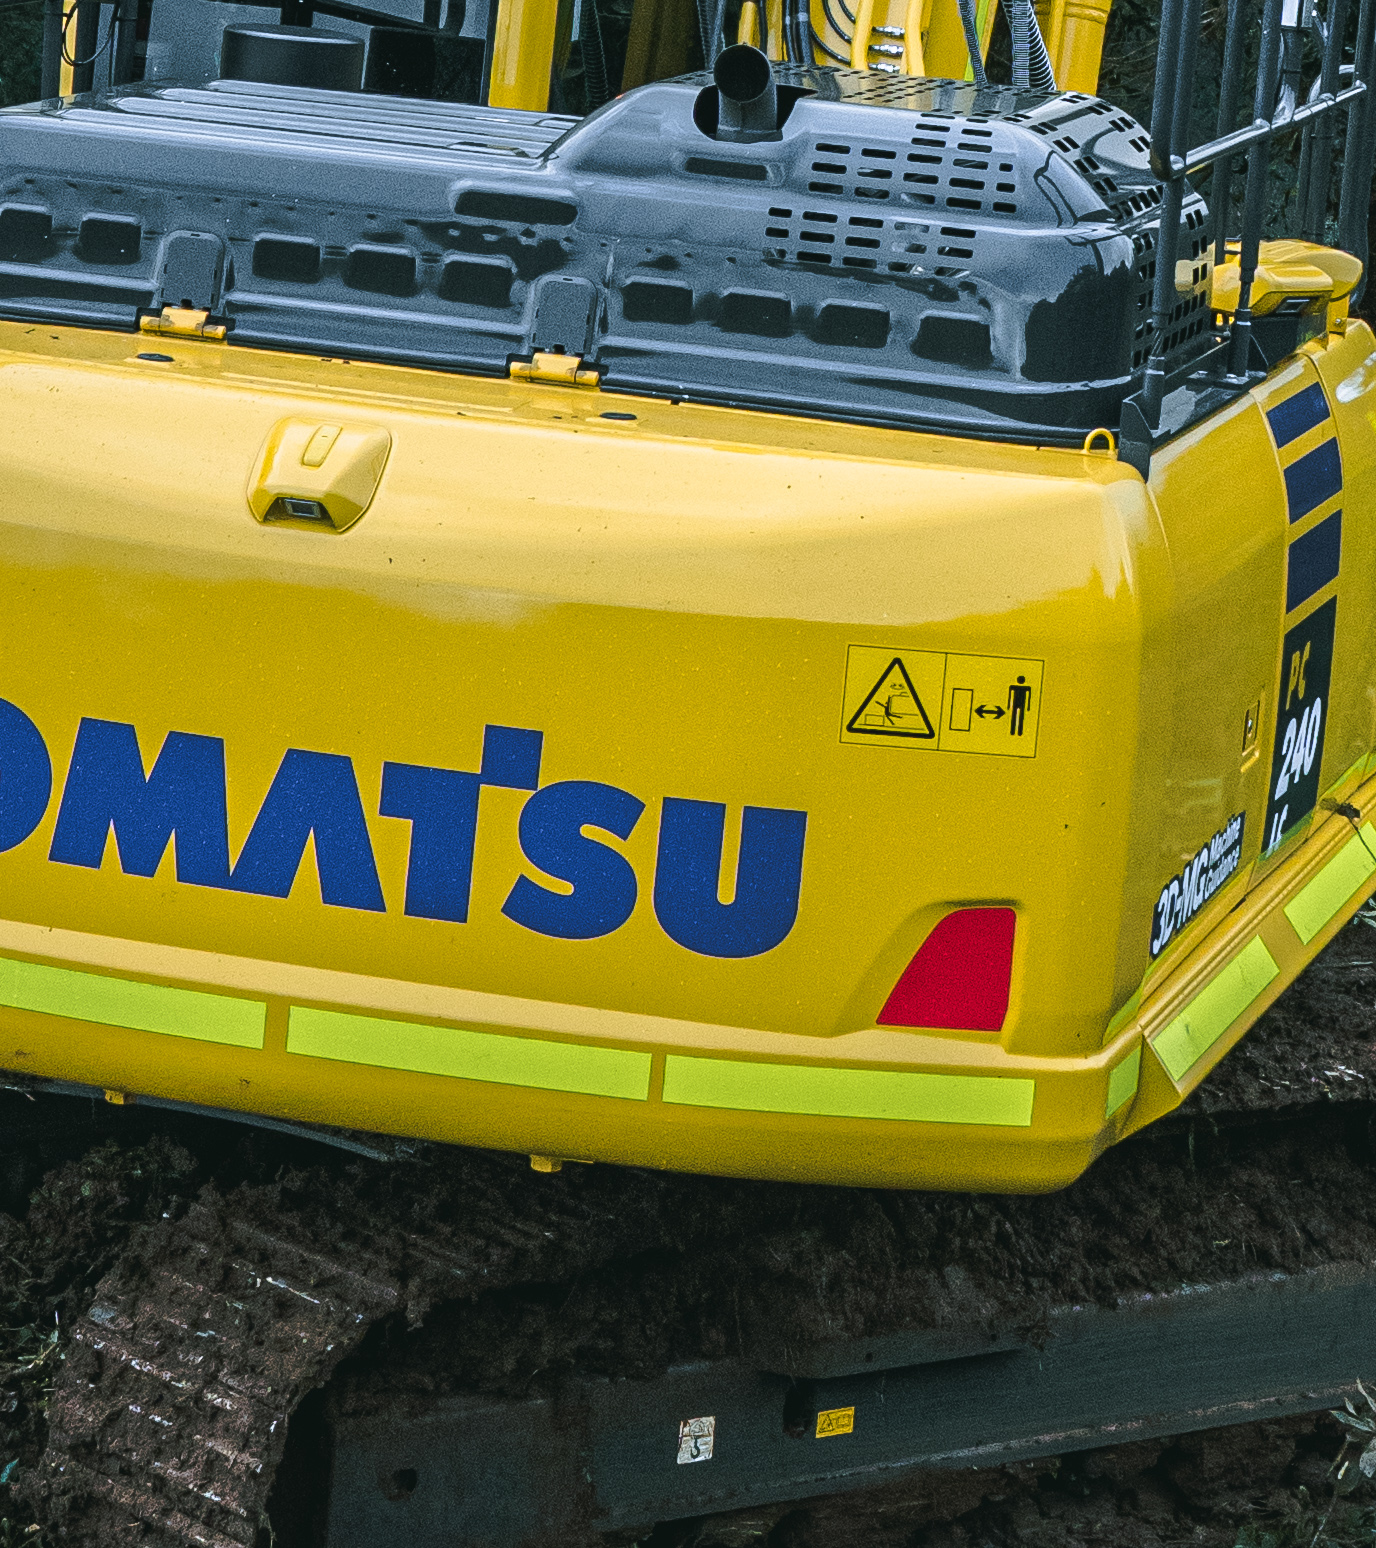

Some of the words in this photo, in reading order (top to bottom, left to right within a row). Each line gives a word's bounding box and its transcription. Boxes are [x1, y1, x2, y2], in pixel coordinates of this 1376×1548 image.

[1285, 640, 1311, 711] PC
[1274, 697, 1322, 801] 240
[1152, 847, 1209, 955] 3D-MG
